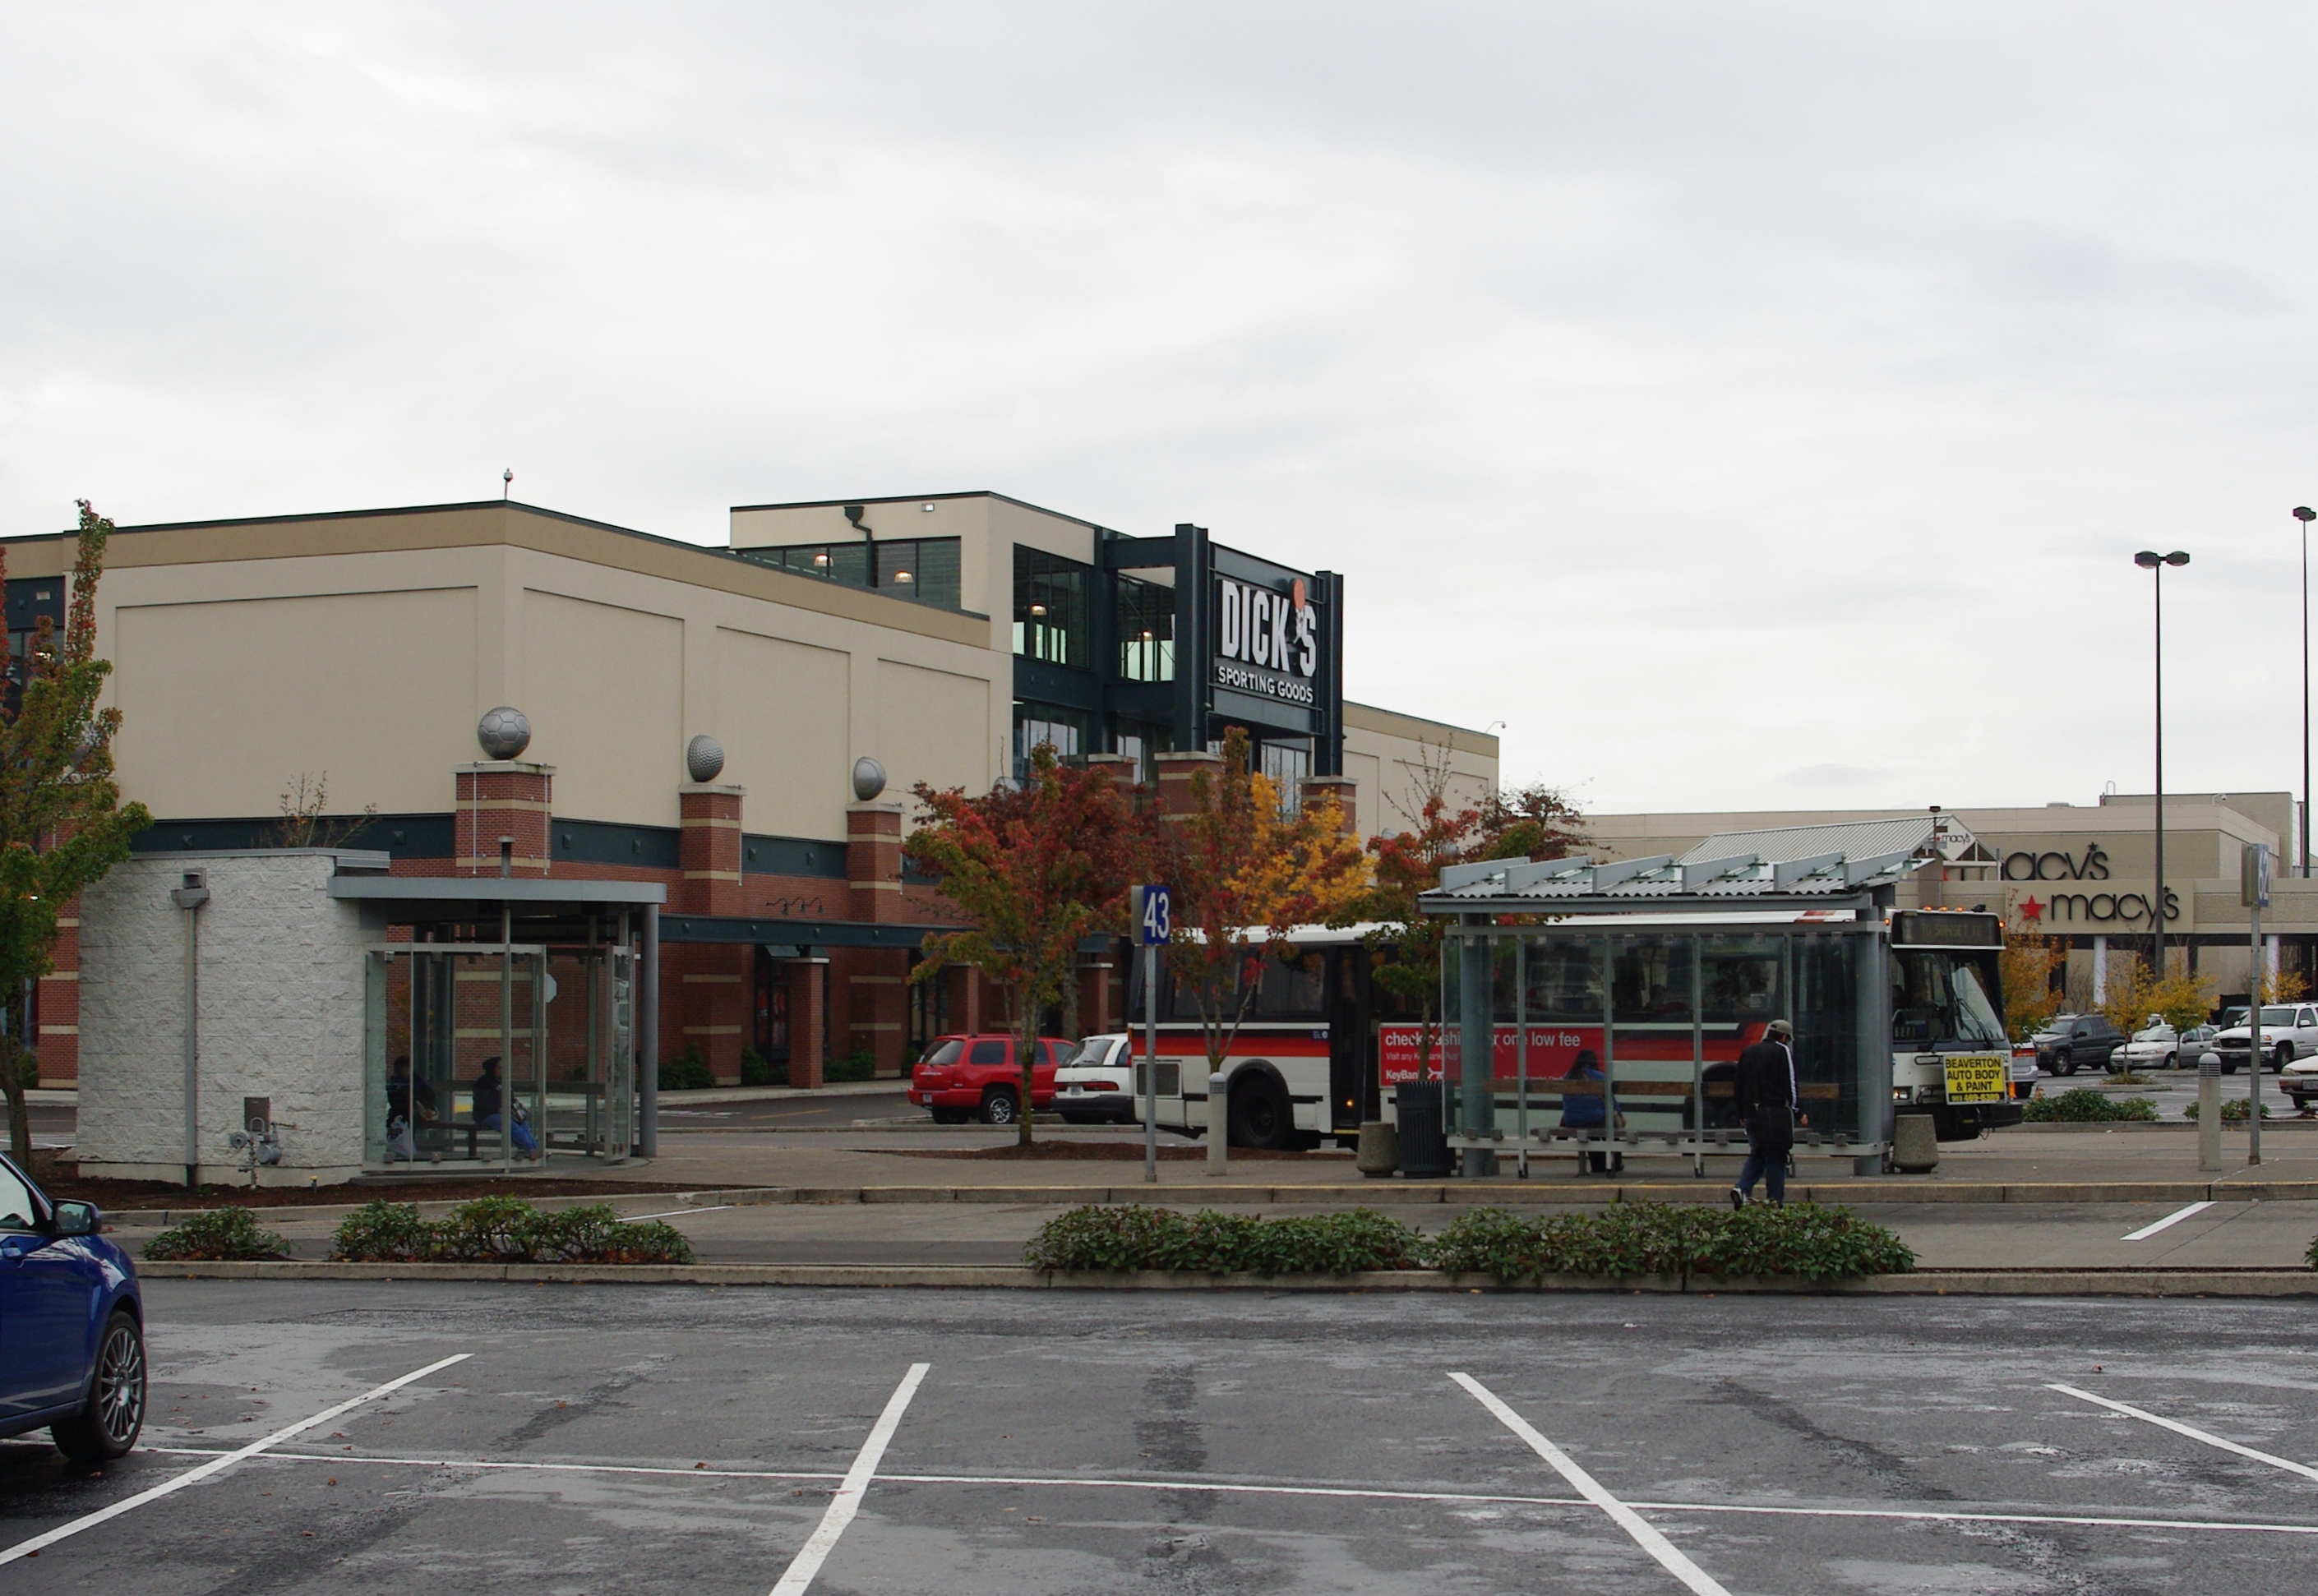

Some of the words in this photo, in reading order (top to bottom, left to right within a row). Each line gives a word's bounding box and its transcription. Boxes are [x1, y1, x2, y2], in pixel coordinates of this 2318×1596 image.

[1221, 578, 1316, 677] DICK'S
[1218, 666, 1275, 694] SPORTING
[1277, 680, 1314, 703] GOODS
[1143, 892, 1171, 939] 43
[2051, 885, 2179, 931] macy's
[1385, 1031, 1421, 1046] check
[1531, 1031, 1555, 1046] low
[1558, 1031, 1581, 1047] fee
[1946, 1059, 2001, 1068] BEAVERTON
[1386, 1069, 1420, 1082] KeyBan
[1947, 1070, 1972, 1080] AUTO
[1974, 1070, 2000, 1079] BODY
[1956, 1082, 1963, 1091] &
[1966, 1082, 1992, 1091] PAINT
